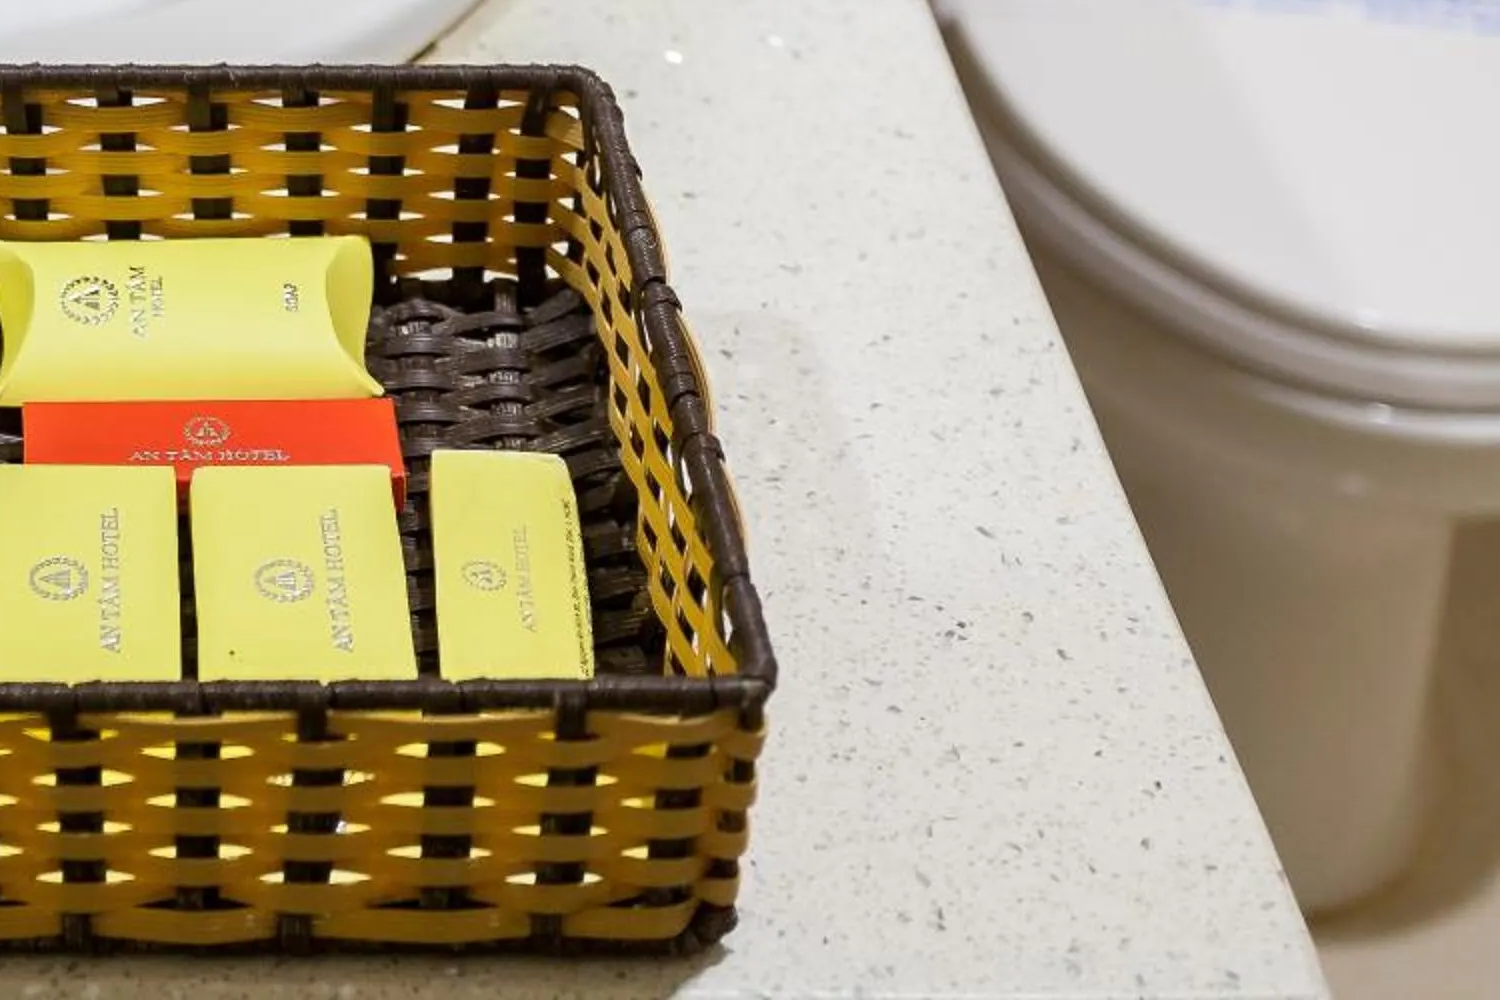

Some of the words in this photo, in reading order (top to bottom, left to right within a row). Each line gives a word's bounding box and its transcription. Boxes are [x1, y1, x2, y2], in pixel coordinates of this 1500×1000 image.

[283, 282, 298, 312] SOAP
[129, 449, 160, 461] AN
[220, 449, 291, 462] HOTEL
[100, 506, 120, 570] HOTEL
[320, 507, 344, 571] HOTEL
[100, 624, 121, 654] AN
[331, 624, 354, 654] AN
